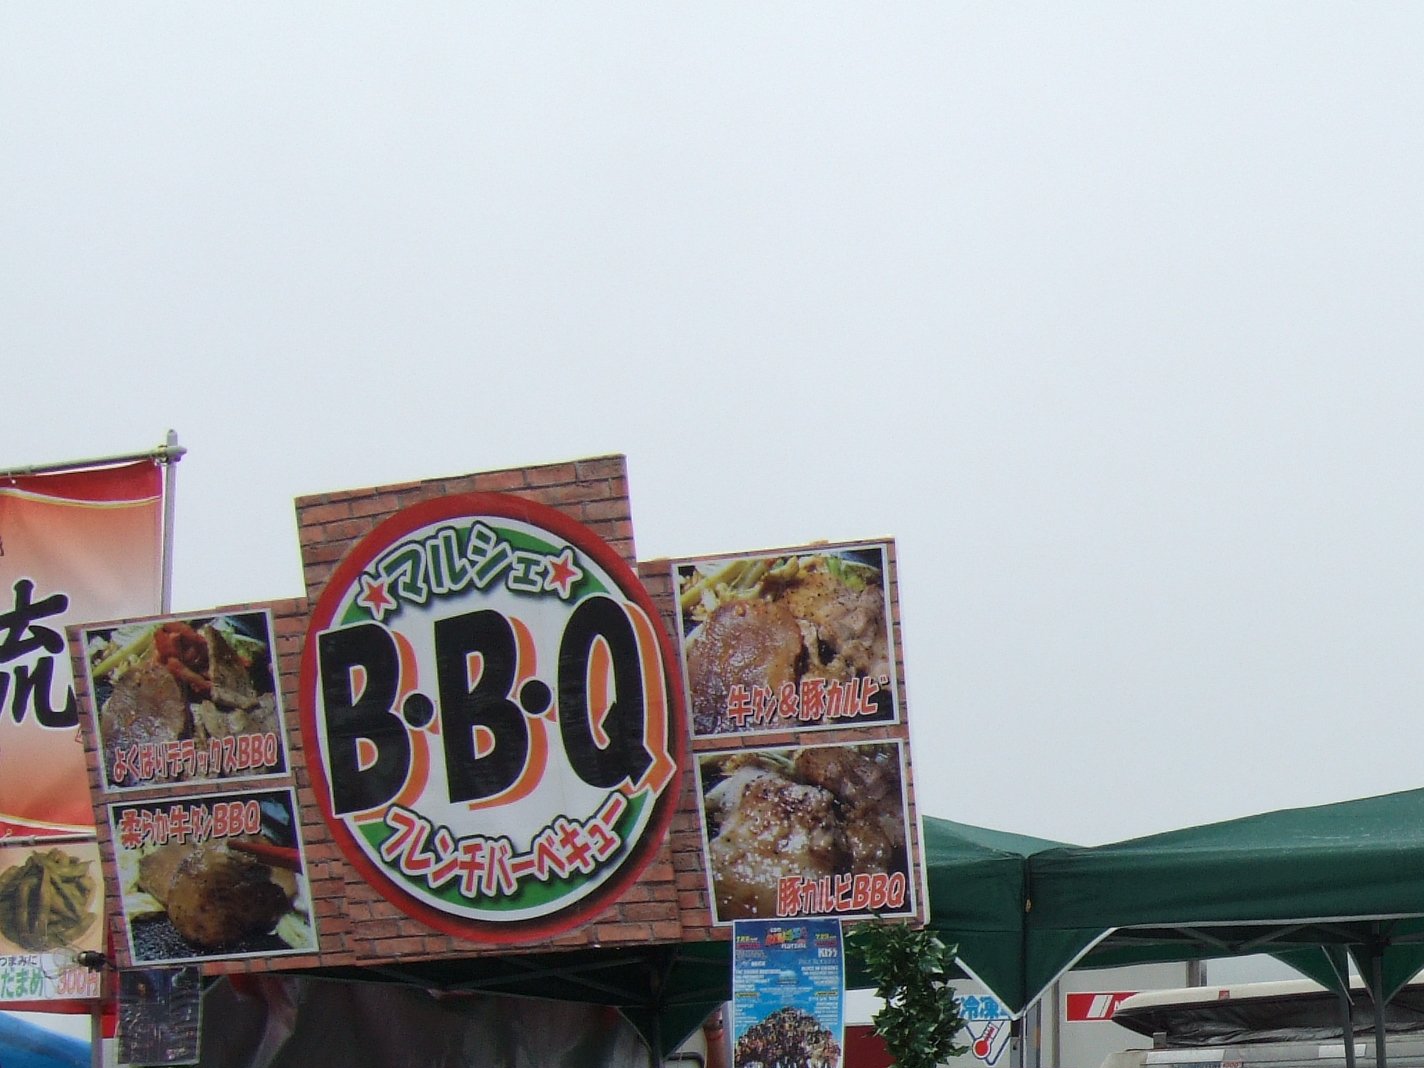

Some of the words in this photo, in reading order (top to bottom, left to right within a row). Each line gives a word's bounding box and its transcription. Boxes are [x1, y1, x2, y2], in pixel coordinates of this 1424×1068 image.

[380, 792, 627, 897] フレンチバーベキュー
[777, 872, 905, 917] 豚カルビBBQ
[960, 995, 1008, 1020] 冷凍
